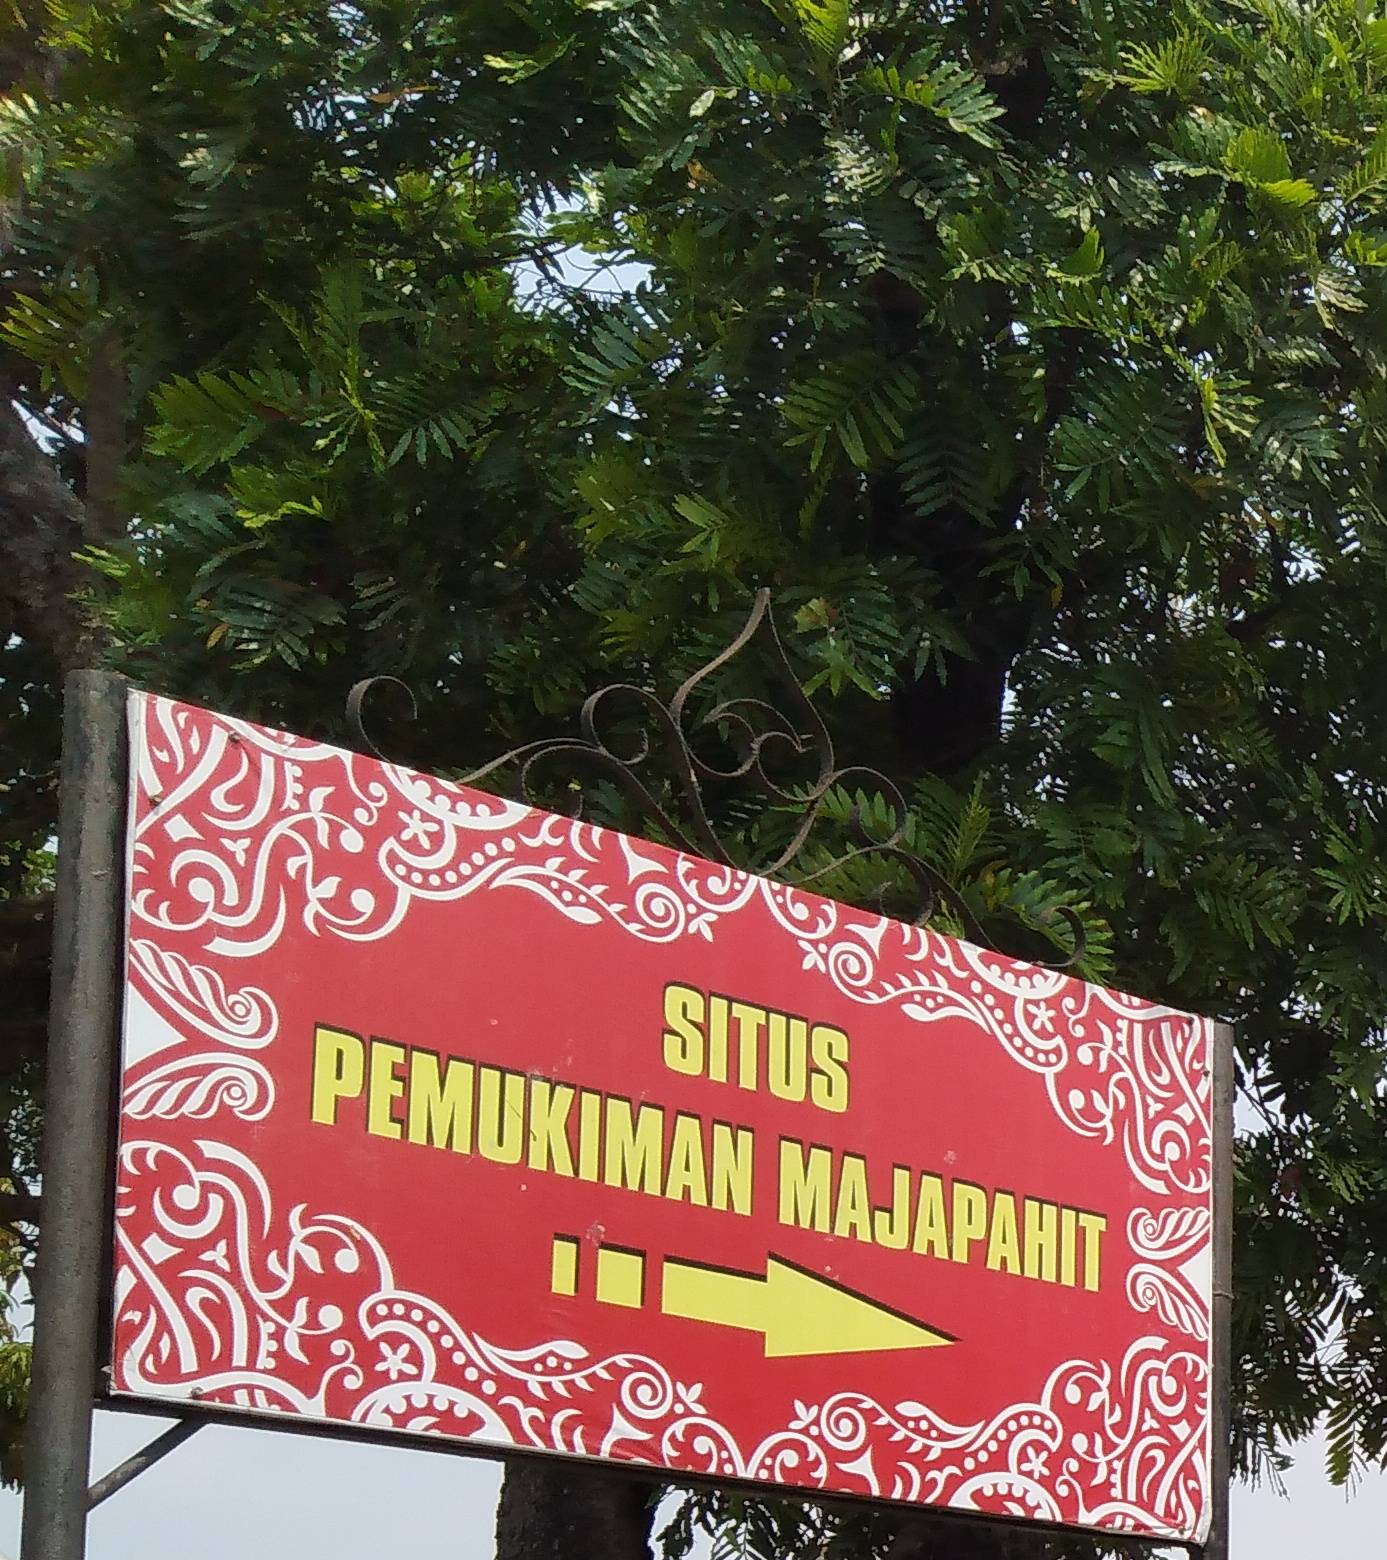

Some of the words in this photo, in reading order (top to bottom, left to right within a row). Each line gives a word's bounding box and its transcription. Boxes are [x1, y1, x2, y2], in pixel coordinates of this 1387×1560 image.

[662, 982, 849, 1112] SITUS
[311, 1024, 754, 1215] PEMUKIMAN
[778, 1139, 1107, 1292] MAJAPAHIT
